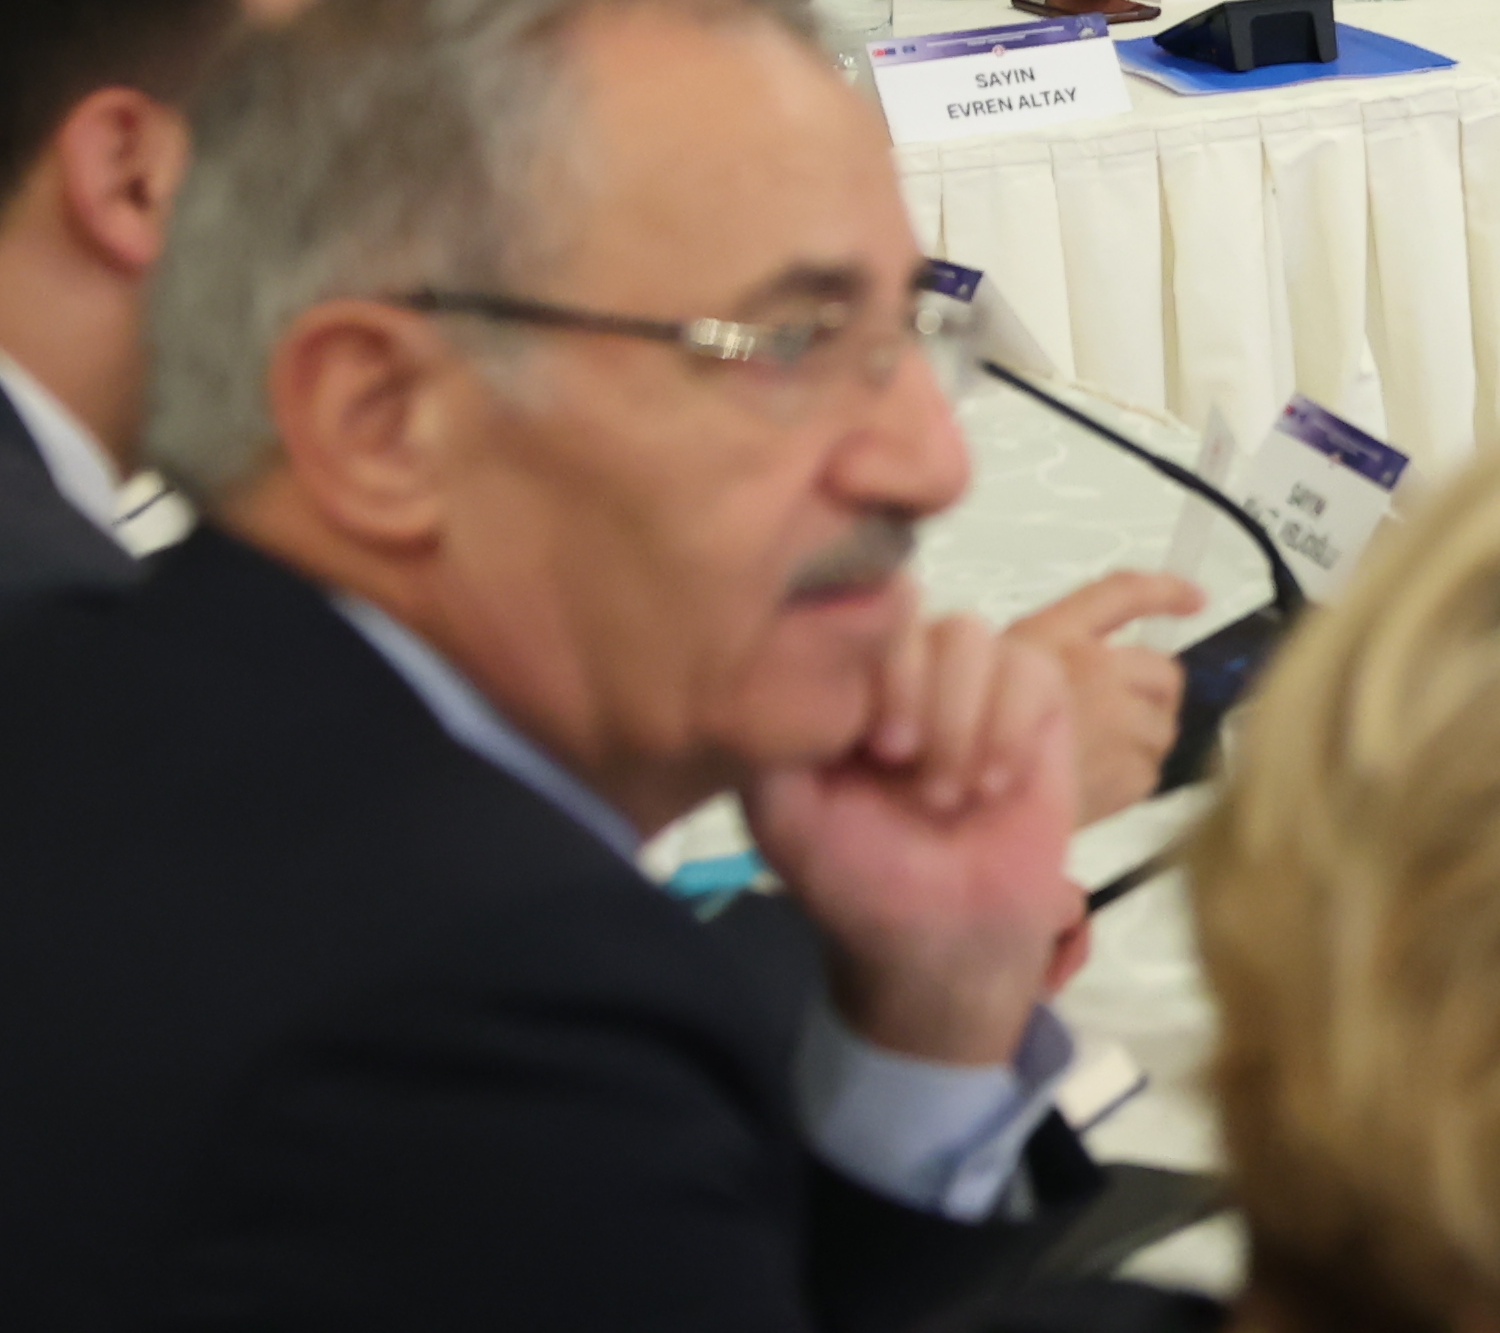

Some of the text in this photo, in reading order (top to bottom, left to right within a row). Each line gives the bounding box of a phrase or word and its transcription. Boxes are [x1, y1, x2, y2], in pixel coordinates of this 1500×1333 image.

[975, 66, 1036, 88] SAYIN
[946, 86, 1078, 120] EVREN ALTAY
